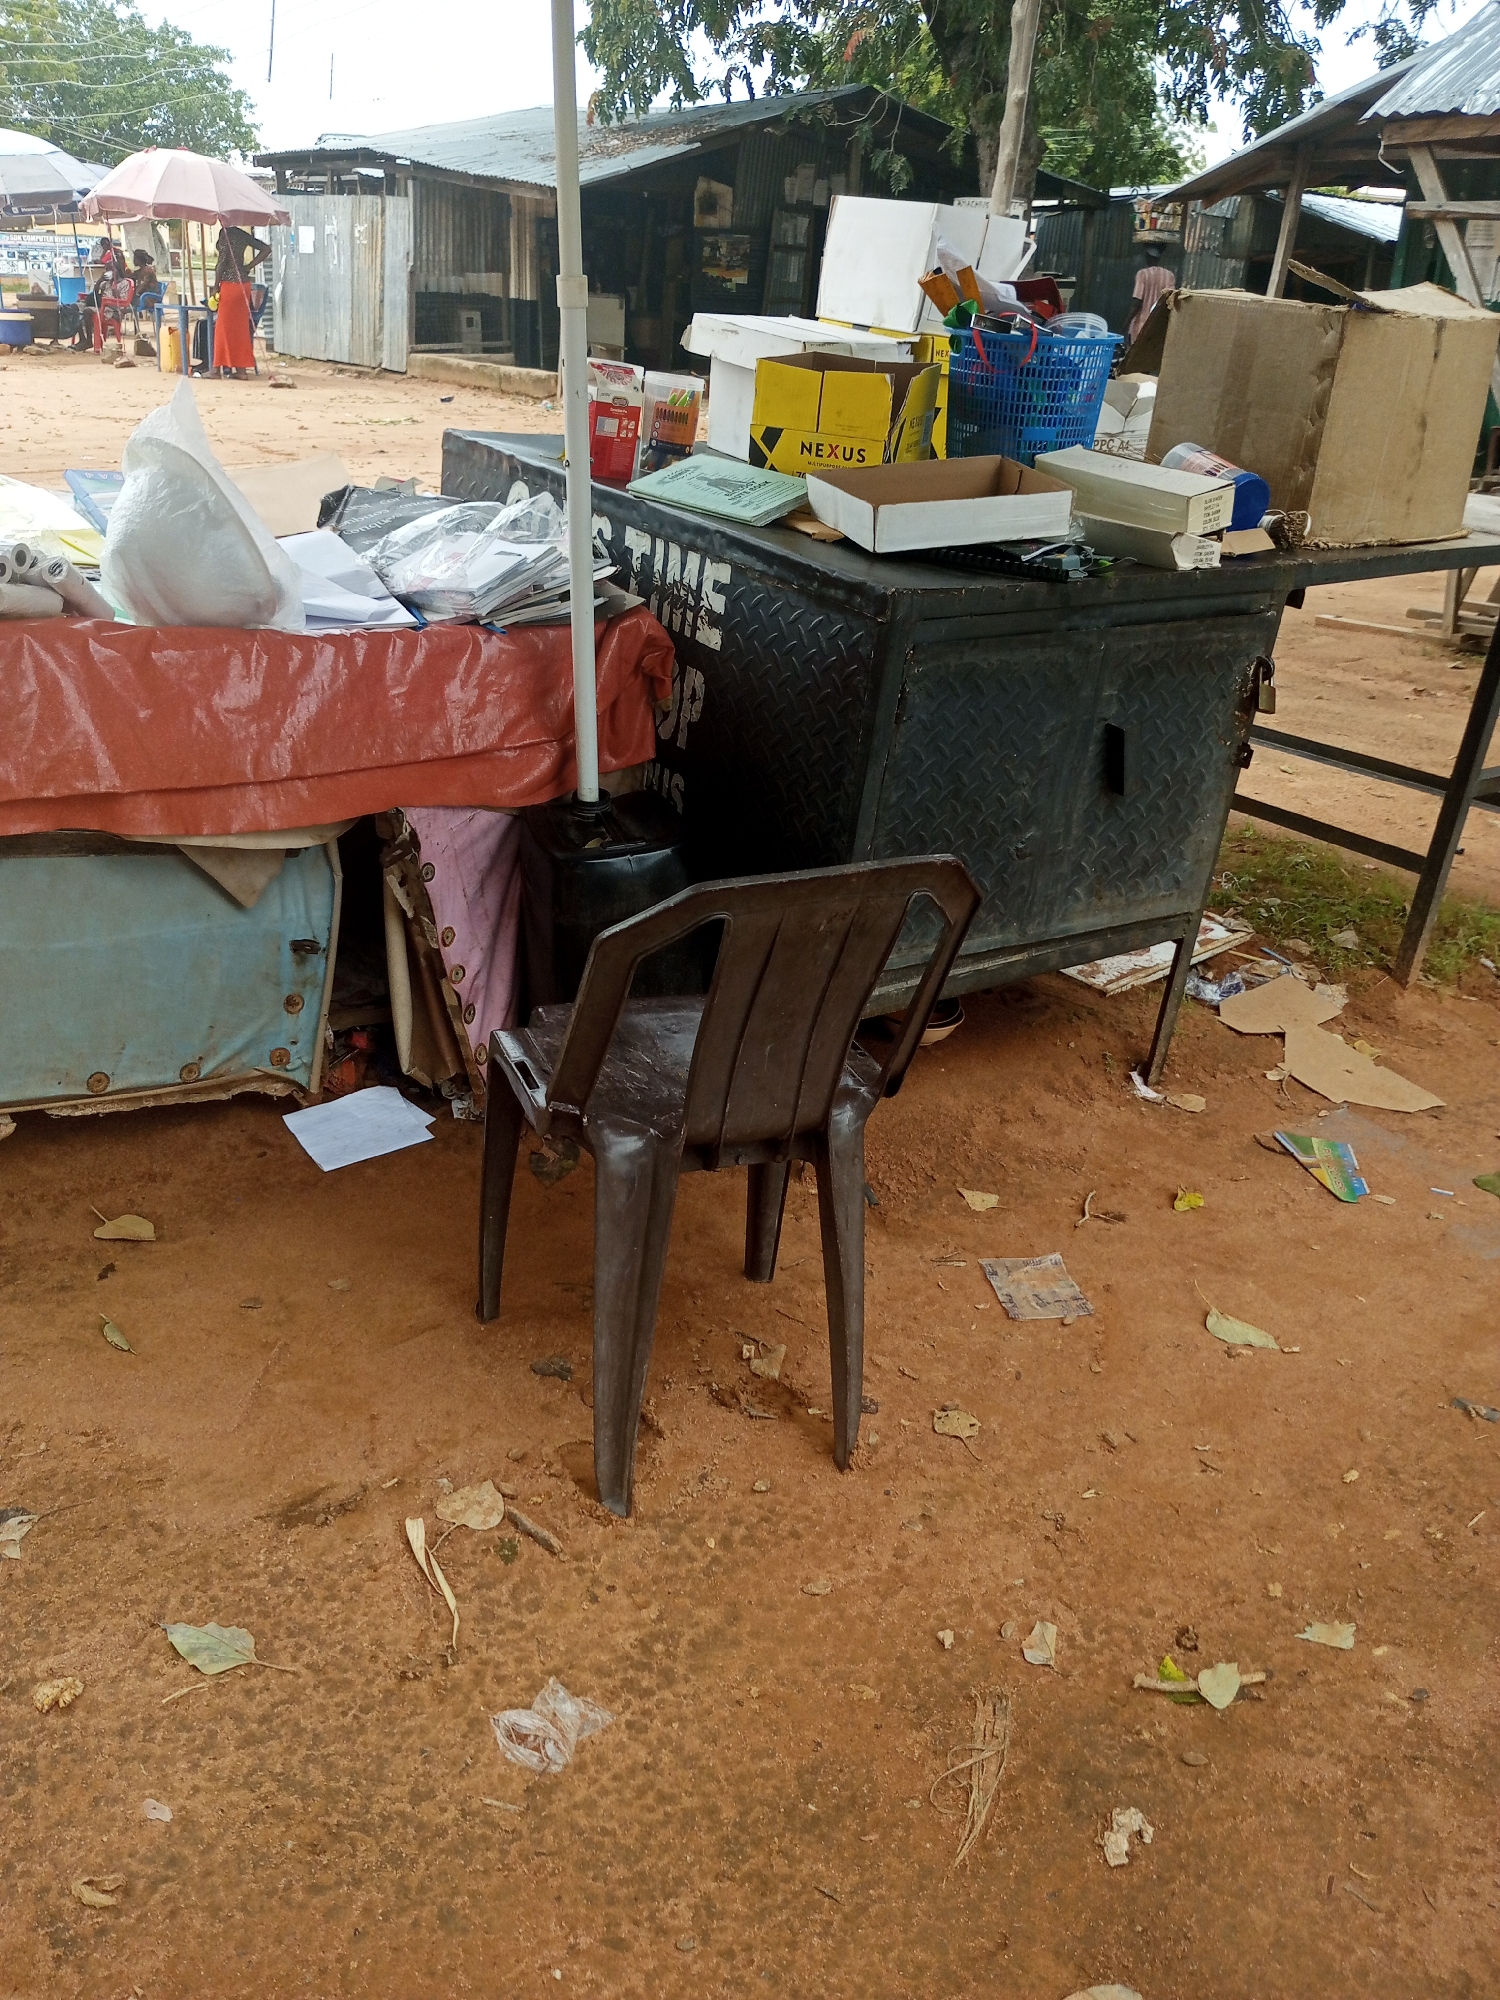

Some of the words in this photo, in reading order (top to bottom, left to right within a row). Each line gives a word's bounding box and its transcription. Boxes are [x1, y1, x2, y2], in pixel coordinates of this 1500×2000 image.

[935, 349, 950, 358] NEX
[800, 441, 867, 464] NEXUS
[624, 526, 731, 651] TIME
